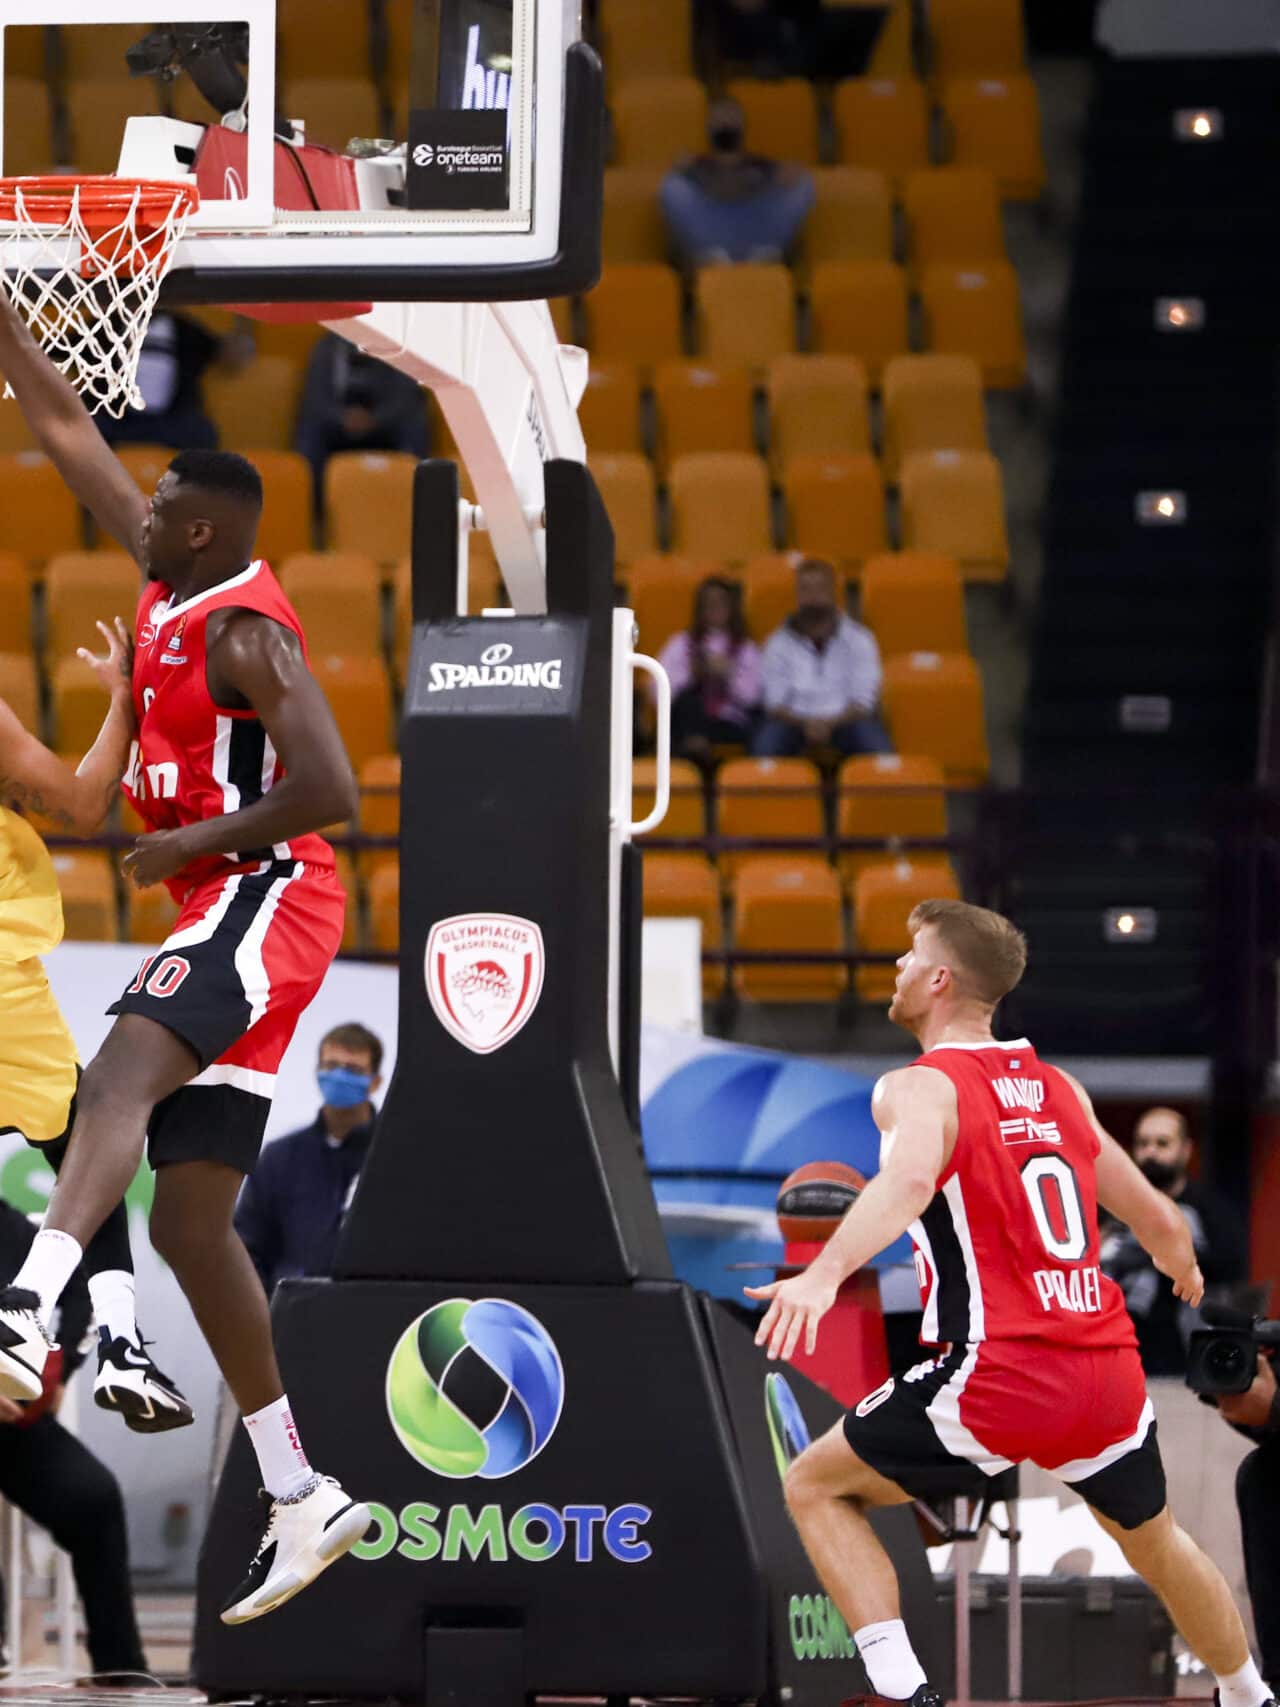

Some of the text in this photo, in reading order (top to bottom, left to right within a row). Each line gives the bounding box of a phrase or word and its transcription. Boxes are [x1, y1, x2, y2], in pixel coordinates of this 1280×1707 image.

[436, 152, 503, 165] oneteam
[427, 659, 563, 692] SPALDING
[441, 925, 529, 943] OLYMPIACOS
[454, 940, 517, 952] BASKETBALL
[127, 954, 191, 998] 10
[1021, 1152, 1090, 1260] 0
[349, 1502, 653, 1563] OSMOTE
[789, 1594, 856, 1660] COSM
